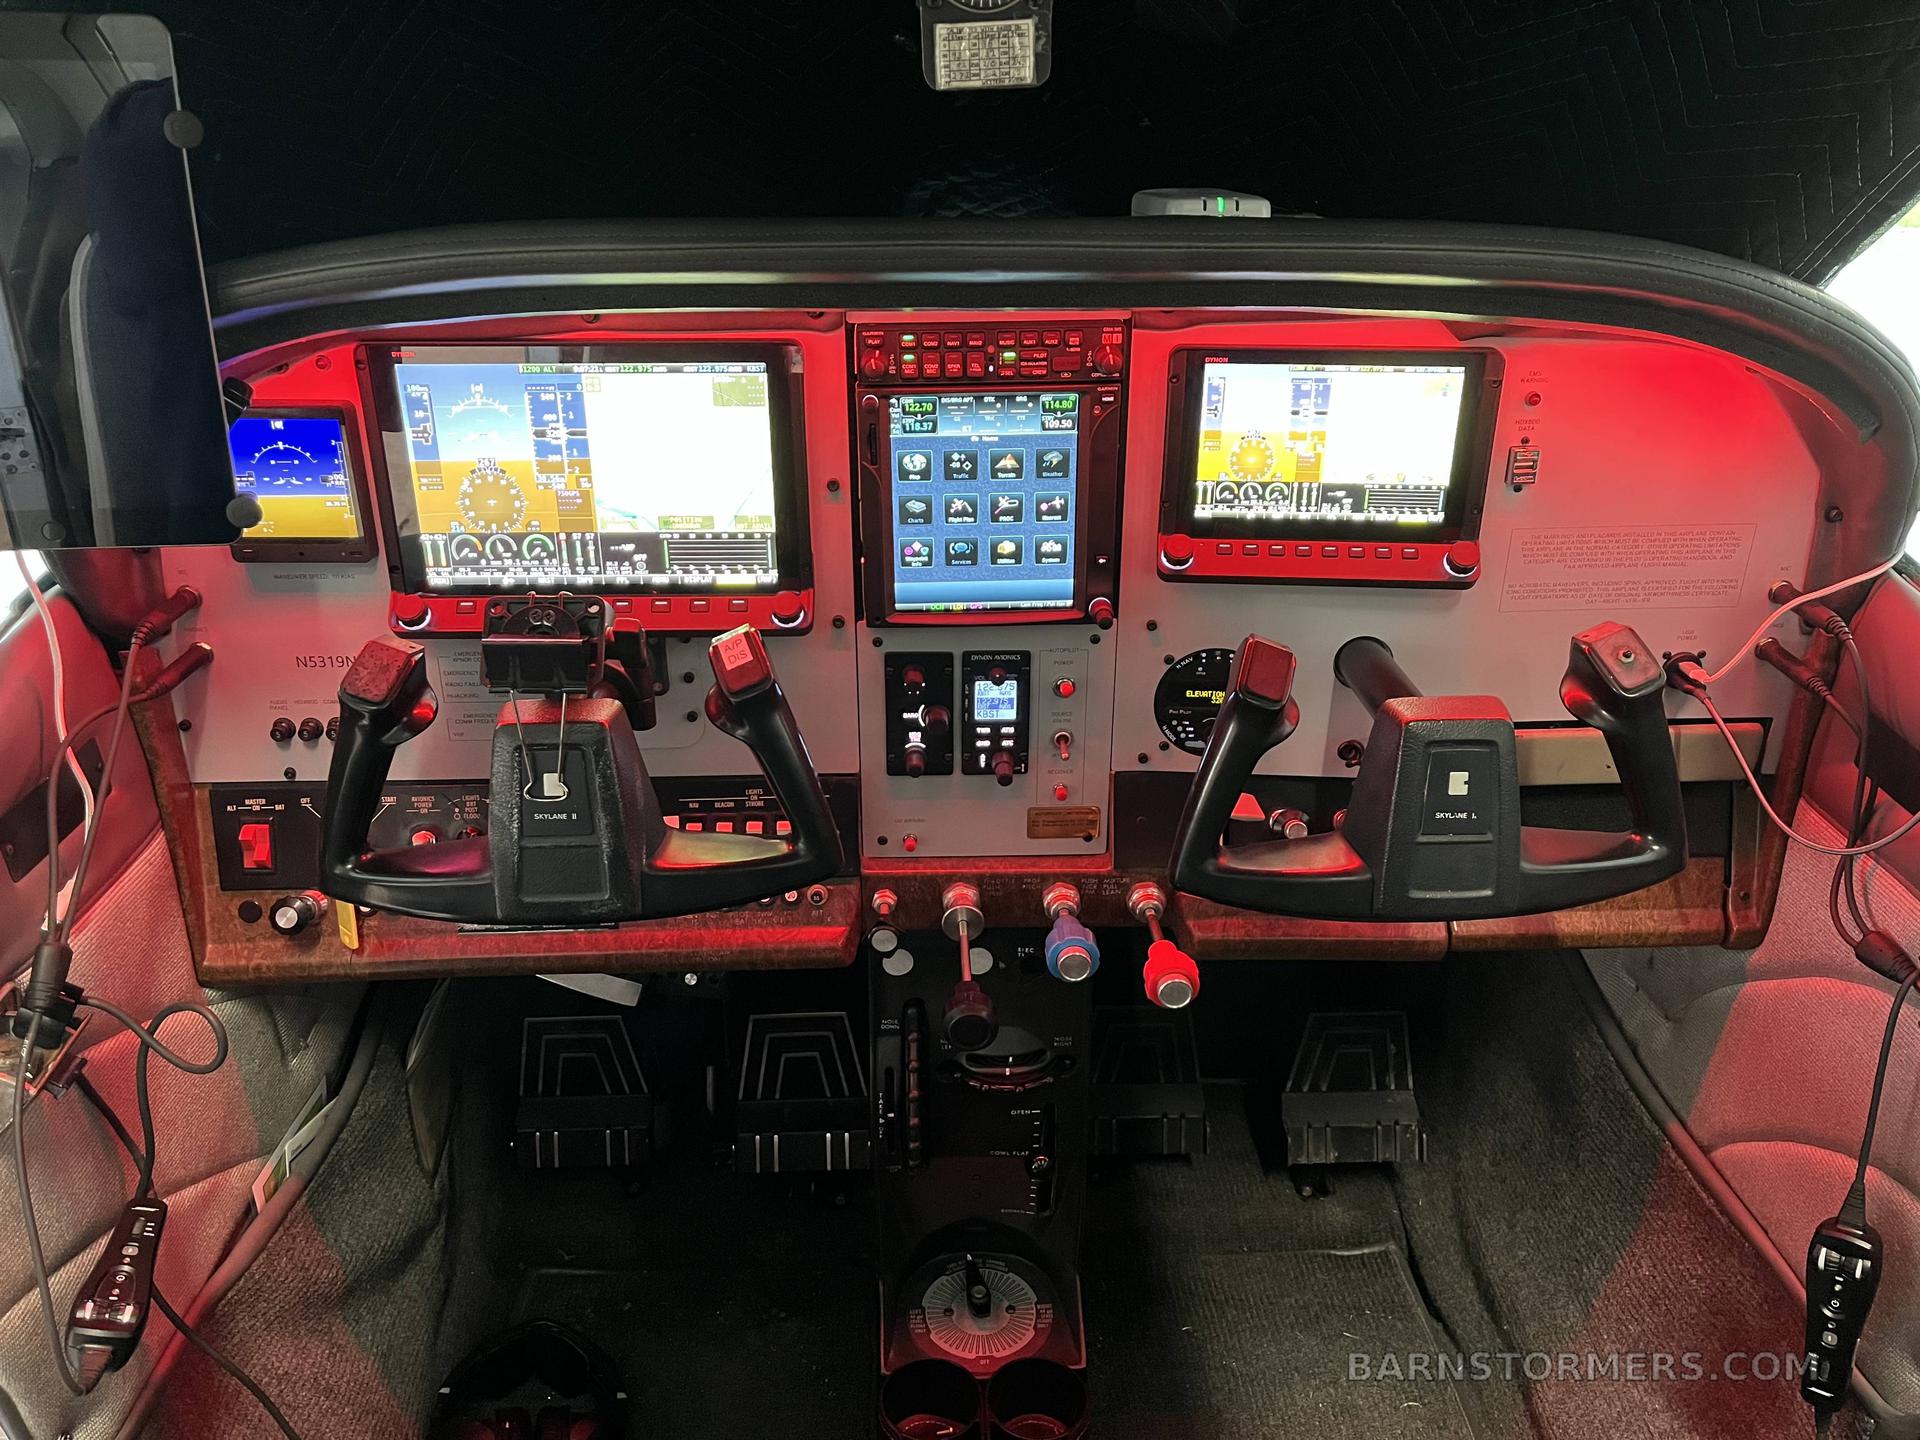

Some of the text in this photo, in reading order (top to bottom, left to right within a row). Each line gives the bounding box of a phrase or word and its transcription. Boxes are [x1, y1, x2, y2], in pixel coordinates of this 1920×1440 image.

[905, 403, 933, 411] 122.70
[1045, 400, 1073, 409] 114.80
[1044, 420, 1073, 428] 109.50
[725, 639, 743, 653] A/P
[728, 650, 748, 665] DIS
[1186, 690, 1226, 698] ELEVATION
